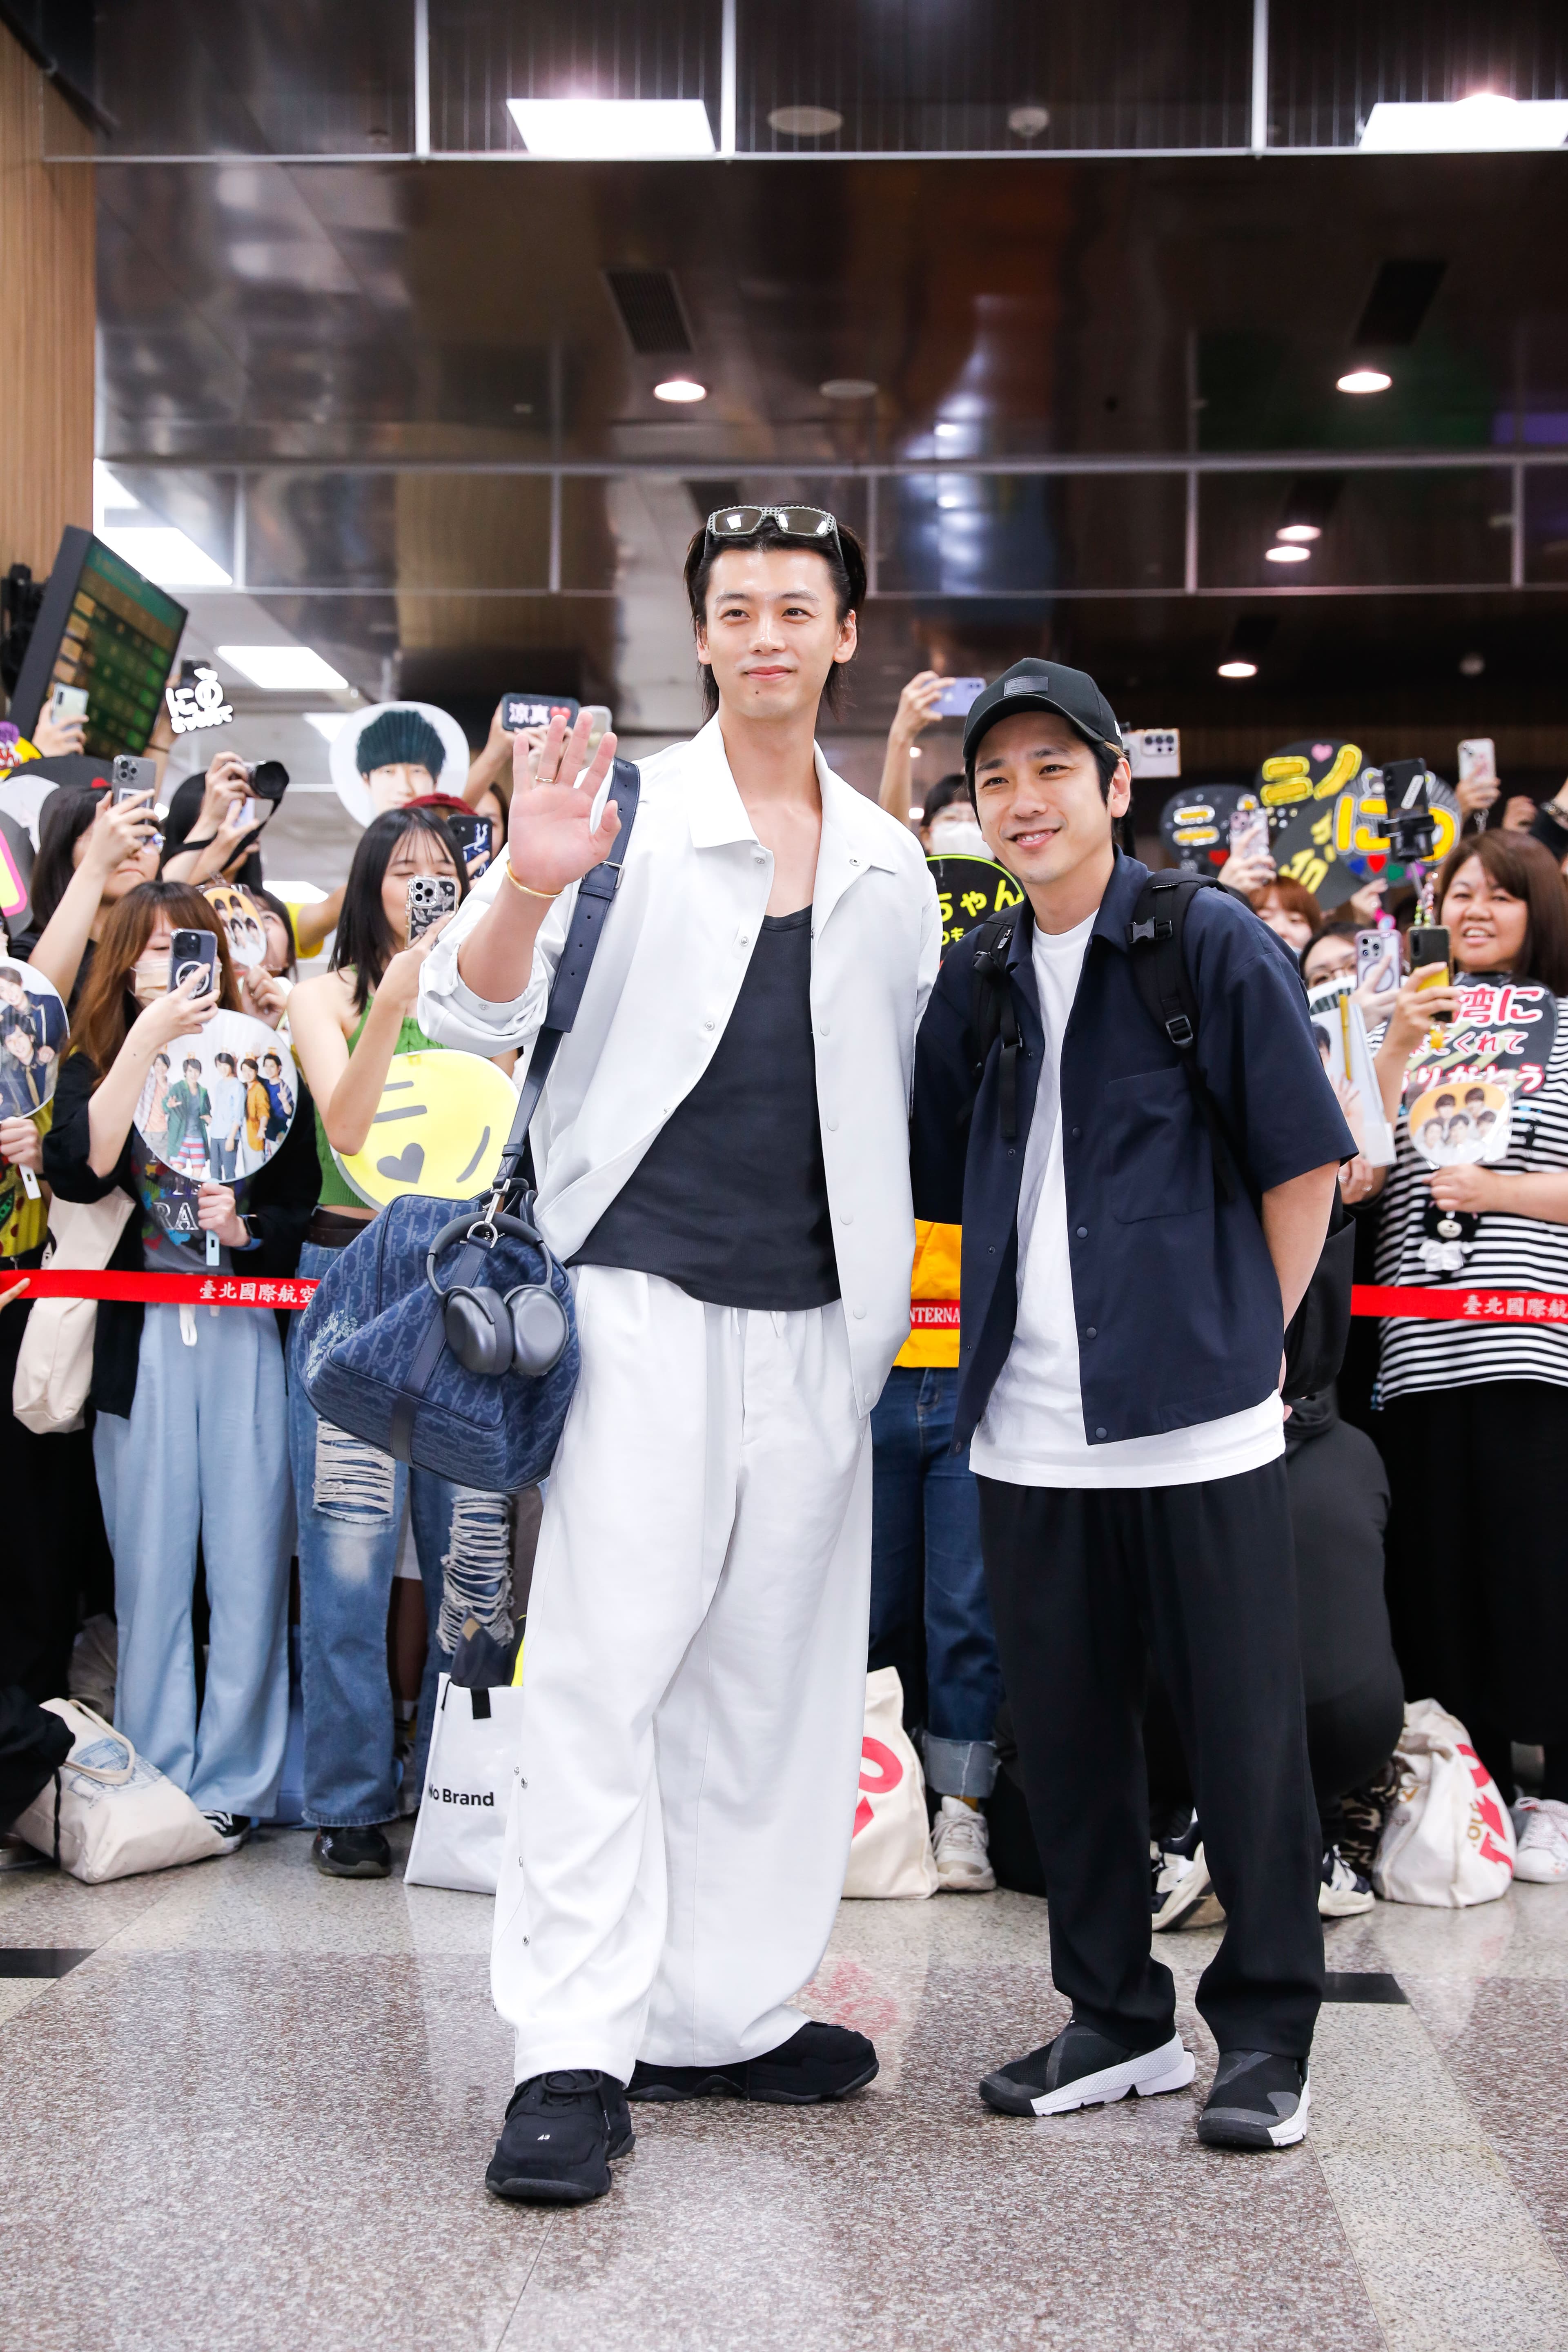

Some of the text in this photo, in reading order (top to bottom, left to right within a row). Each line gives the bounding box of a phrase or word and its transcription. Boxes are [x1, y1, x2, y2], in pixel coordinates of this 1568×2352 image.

[199, 1279, 316, 1303] 臺北國際航空
[1462, 1294, 1568, 1319] 臺北國際航
[443, 1788, 494, 1806] Brand
